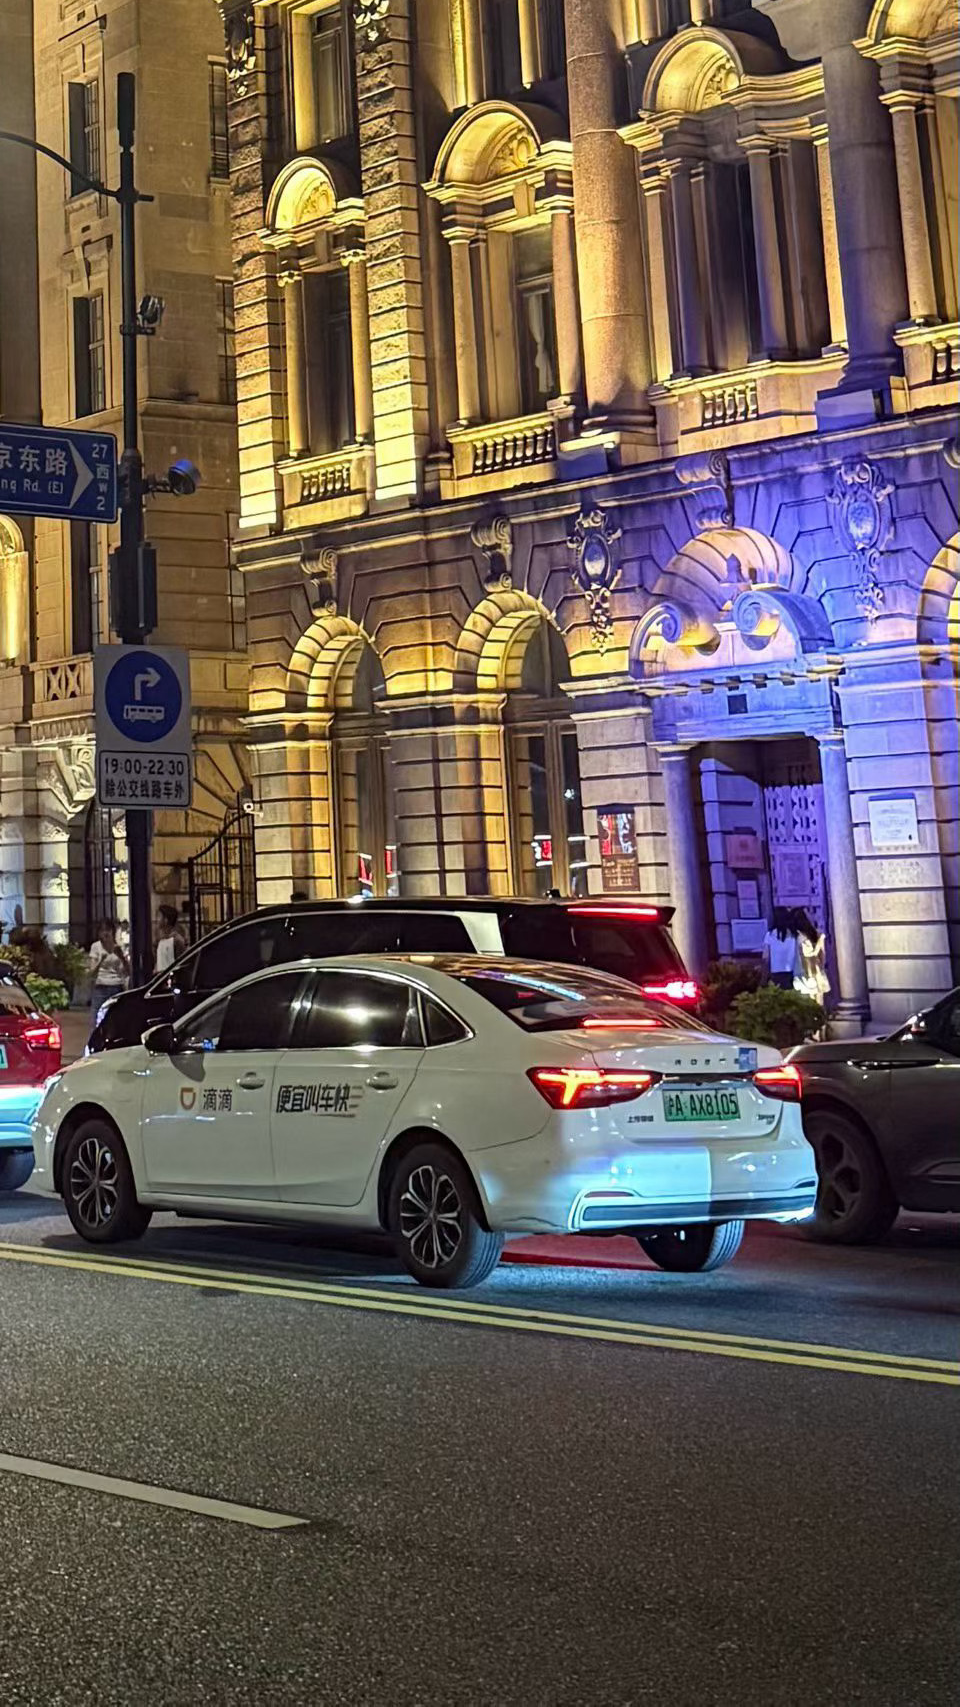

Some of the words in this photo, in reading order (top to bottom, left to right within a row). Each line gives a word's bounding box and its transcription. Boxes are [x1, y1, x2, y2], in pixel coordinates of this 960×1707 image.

[92, 443, 108, 459] 27
[96, 463, 110, 480] 西
[48, 480, 64, 495] (E)
[98, 483, 108, 493] W
[96, 496, 106, 511] 2
[104, 777, 185, 800] 除公交线路车外
[203, 1089, 232, 1111] 滴滴
[276, 1083, 351, 1113] 便宜叫车快
